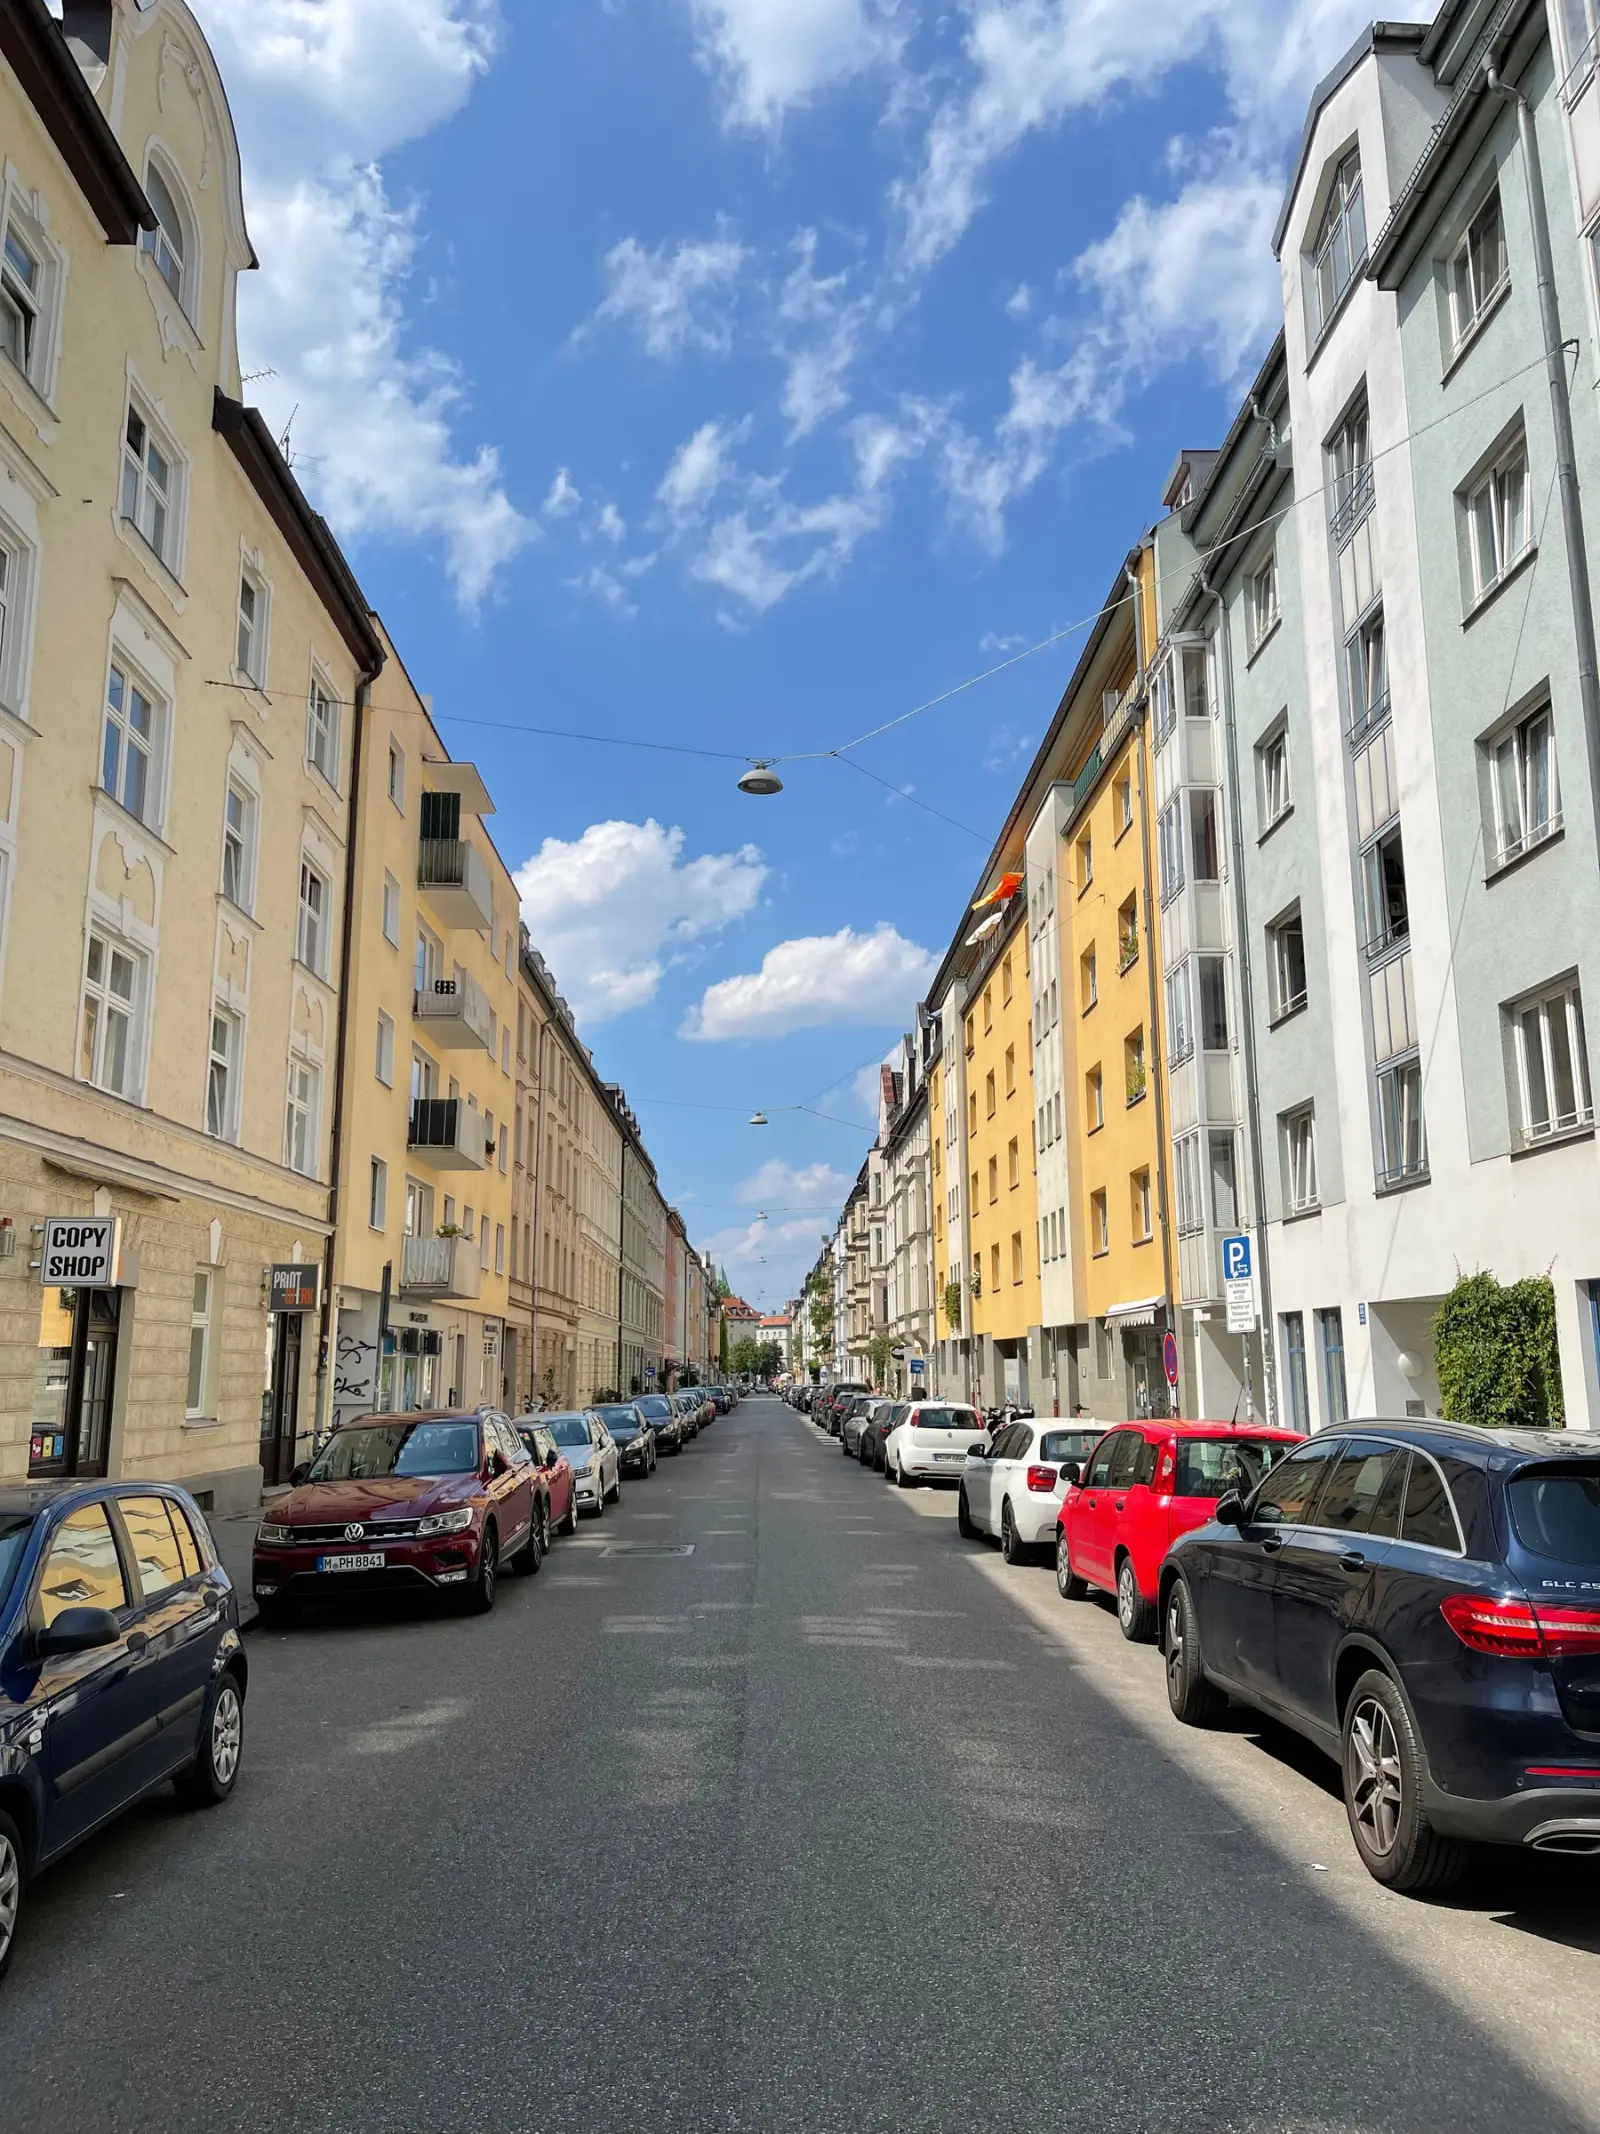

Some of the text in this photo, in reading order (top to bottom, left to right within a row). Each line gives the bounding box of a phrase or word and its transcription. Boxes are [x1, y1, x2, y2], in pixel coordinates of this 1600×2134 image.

[52, 1227, 107, 1248] COPY
[49, 1256, 105, 1277] SHOP
[1229, 1242, 1244, 1275] P
[324, 1555, 383, 1569] M PH 8841
[1542, 1580, 1577, 1588] GLC
